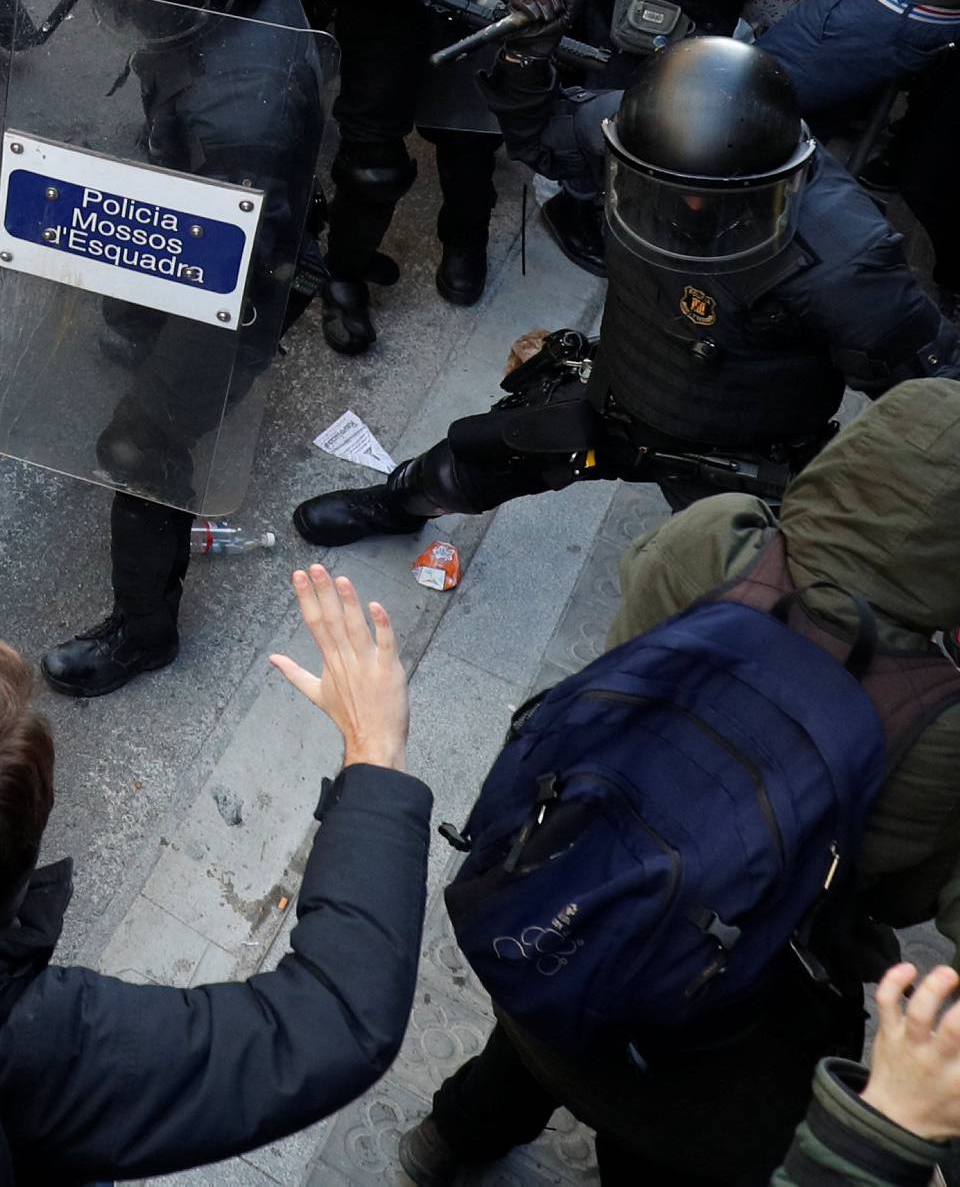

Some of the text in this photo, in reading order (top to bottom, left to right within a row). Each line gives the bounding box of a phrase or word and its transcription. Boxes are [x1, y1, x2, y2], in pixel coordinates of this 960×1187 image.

[71, 207, 183, 254] Mossos
[82, 188, 178, 232] Policia
[45, 225, 204, 283] d'Esquadra
